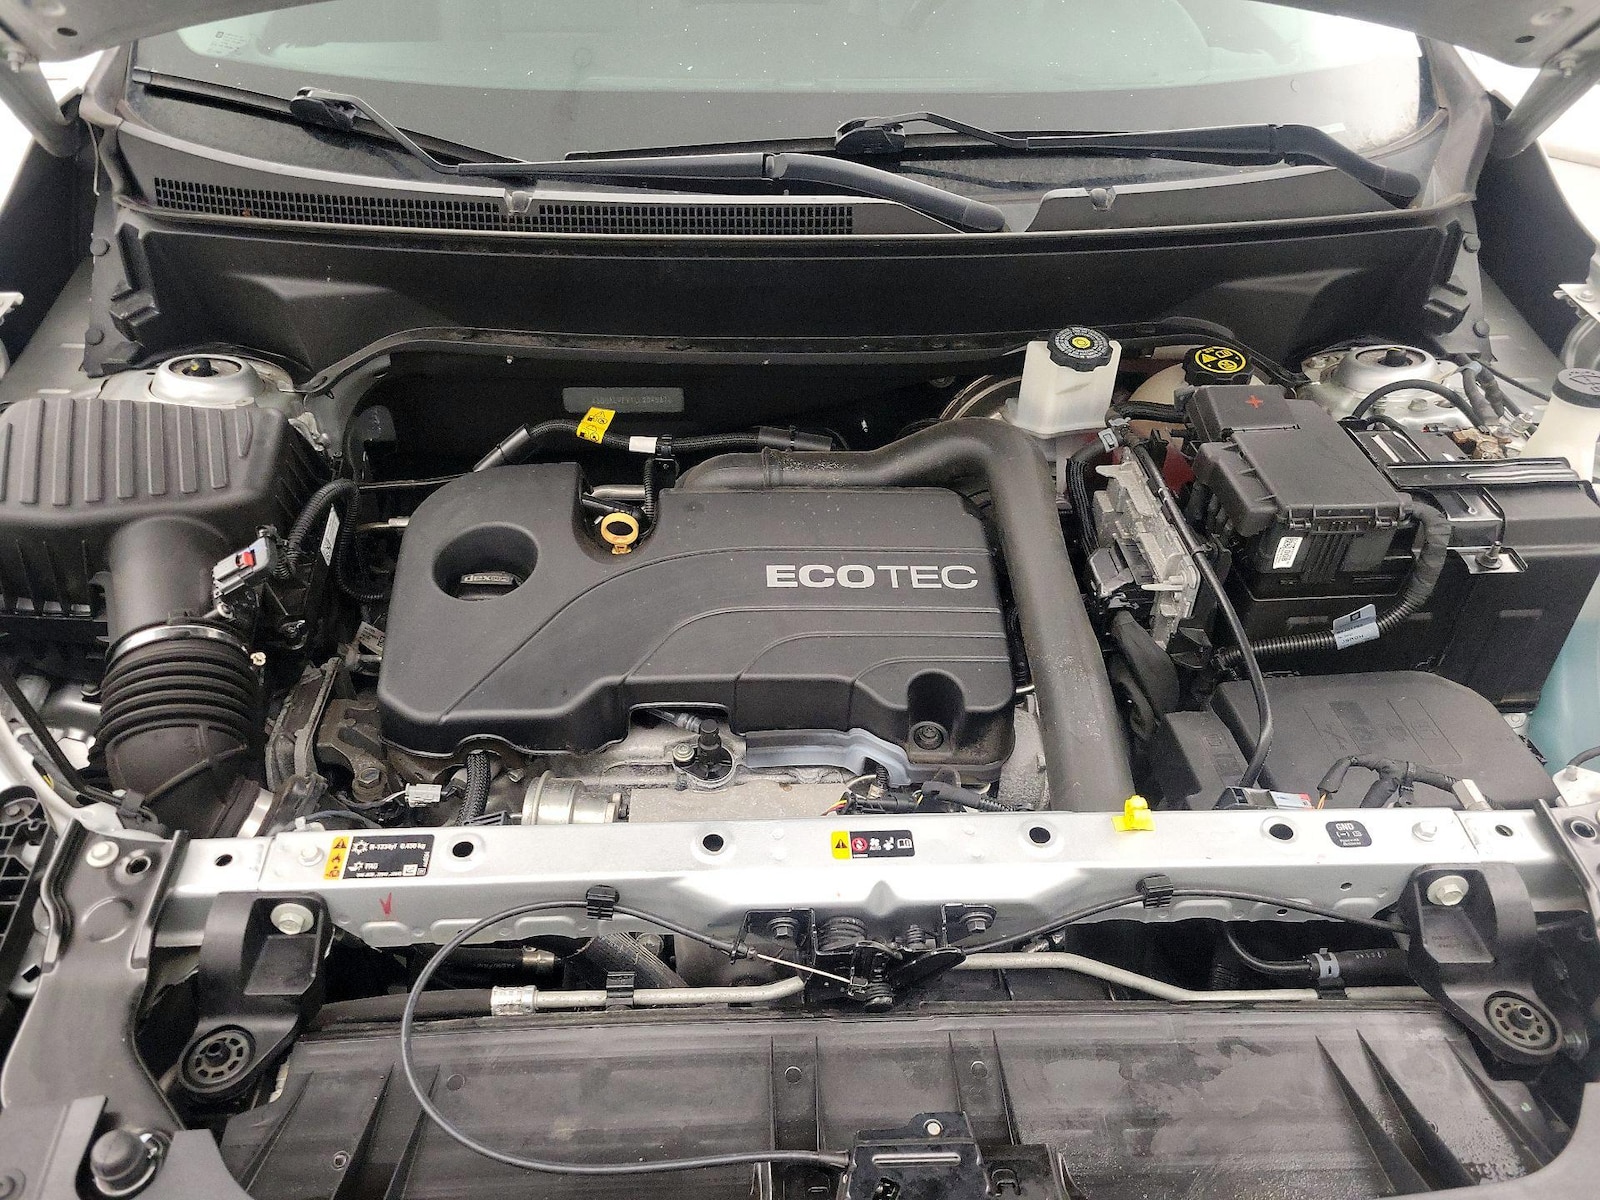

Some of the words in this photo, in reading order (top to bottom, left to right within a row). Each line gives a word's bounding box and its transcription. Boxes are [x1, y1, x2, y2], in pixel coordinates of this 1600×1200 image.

[464, 574, 509, 583] dexos
[766, 564, 978, 589] ECOTEC
[1335, 822, 1354, 831] GND
